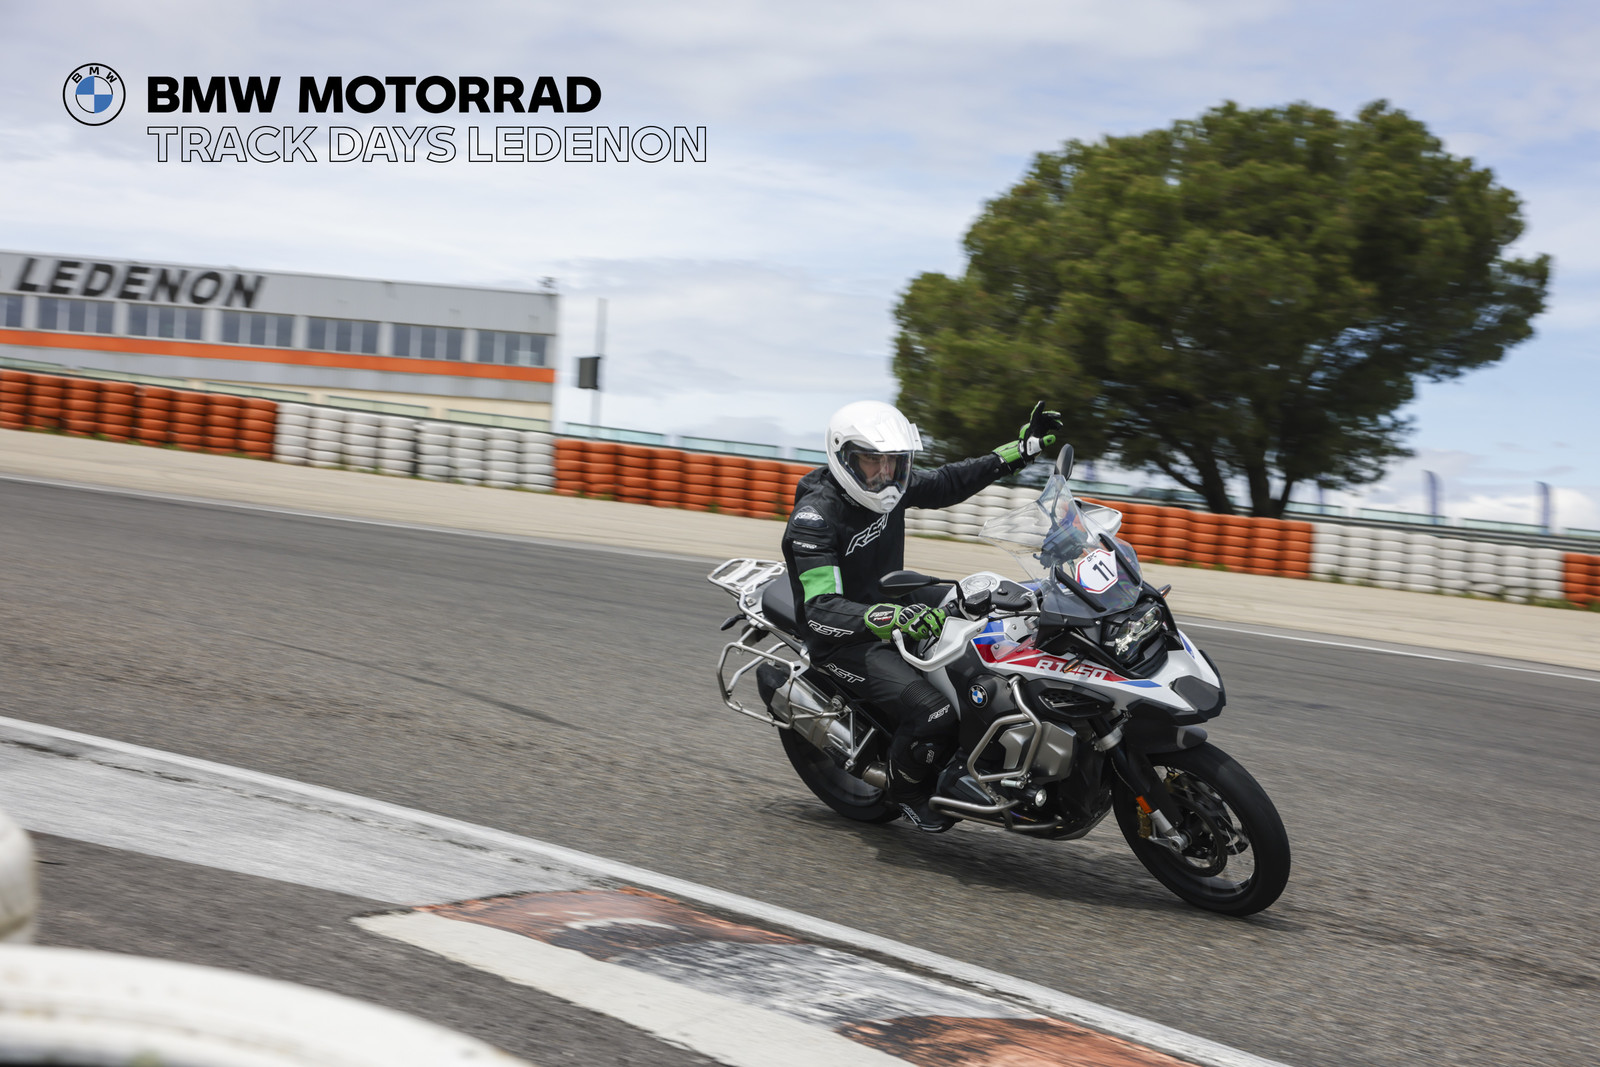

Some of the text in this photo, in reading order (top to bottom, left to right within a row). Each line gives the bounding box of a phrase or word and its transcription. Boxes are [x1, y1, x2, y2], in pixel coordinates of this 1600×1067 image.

[16, 256, 265, 308] LEDENON
[1092, 560, 1115, 581] 11
[807, 619, 854, 638] RST
[824, 663, 866, 683] RST
[928, 704, 950, 723] RST
